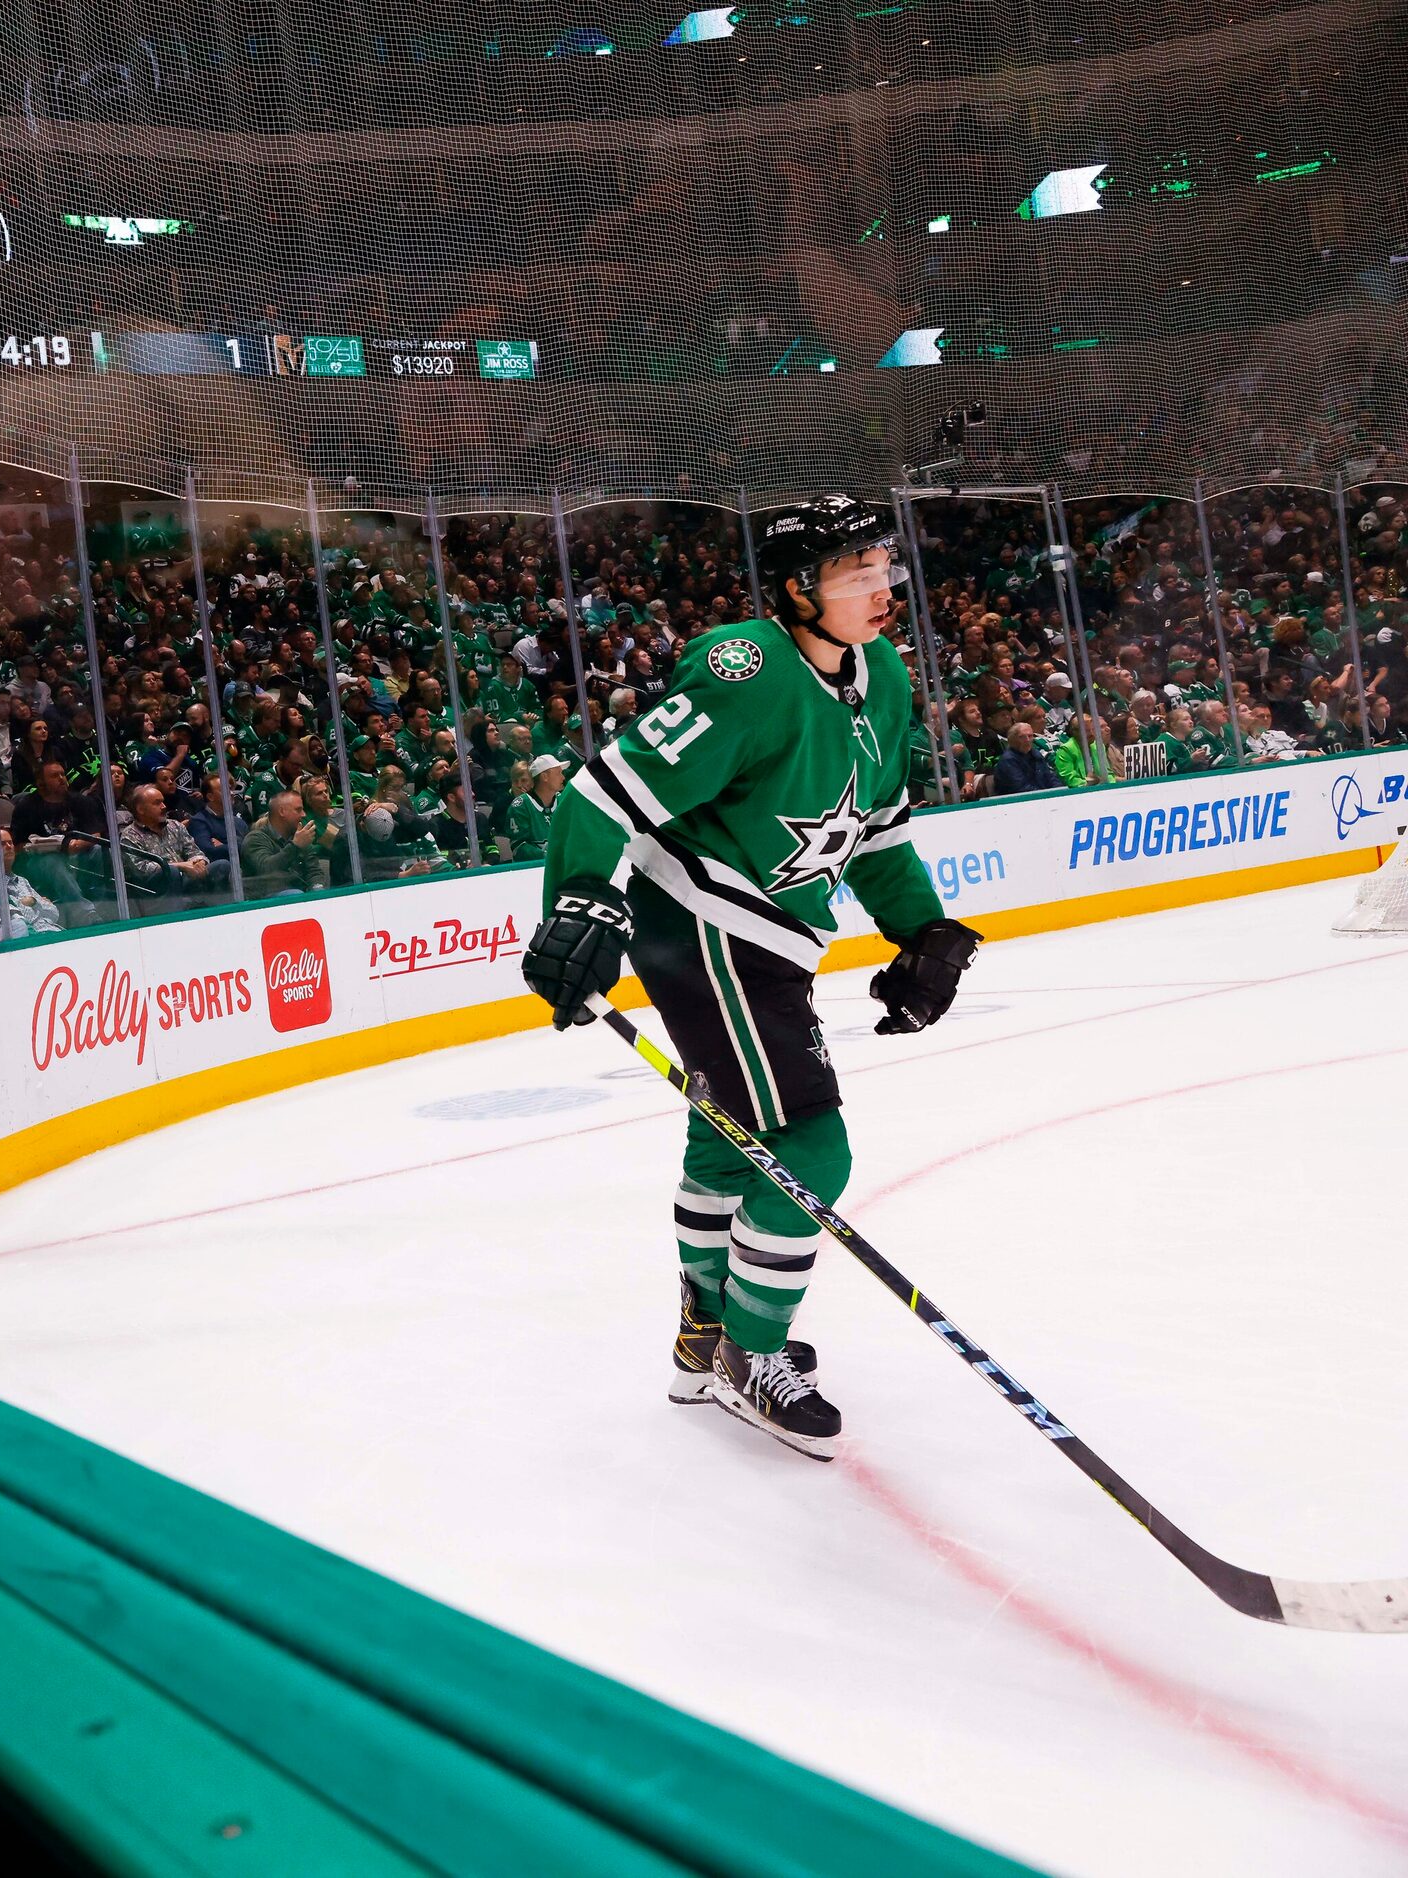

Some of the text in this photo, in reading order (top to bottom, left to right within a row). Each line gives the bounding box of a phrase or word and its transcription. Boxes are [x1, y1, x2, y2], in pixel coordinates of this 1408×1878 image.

[1, 336, 71, 366] 4:19
[225, 339, 241, 369] 1
[373, 340, 467, 351] CURRENT JACKPOT
[393, 355, 454, 376] $13920
[485, 359, 529, 370] JIM ROSS
[775, 524, 806, 534] TRANSFER
[776, 516, 801, 527] ENERGY
[849, 515, 877, 531] CCM
[636, 692, 714, 766] 21
[1125, 745, 1168, 780] #BANG
[177, 772, 191, 785] NHL
[1069, 790, 1291, 870] PROGRESSIVE
[555, 895, 635, 941] CCM
[364, 914, 521, 972] Pep Boys
[268, 948, 324, 989] Bally
[282, 983, 314, 1004] SPORTS
[31, 959, 252, 1072] Bally SPORTS
[697, 1099, 748, 1144] SUPER
[743, 1139, 824, 1212] TACKS
[928, 1320, 1076, 1440] CCM
